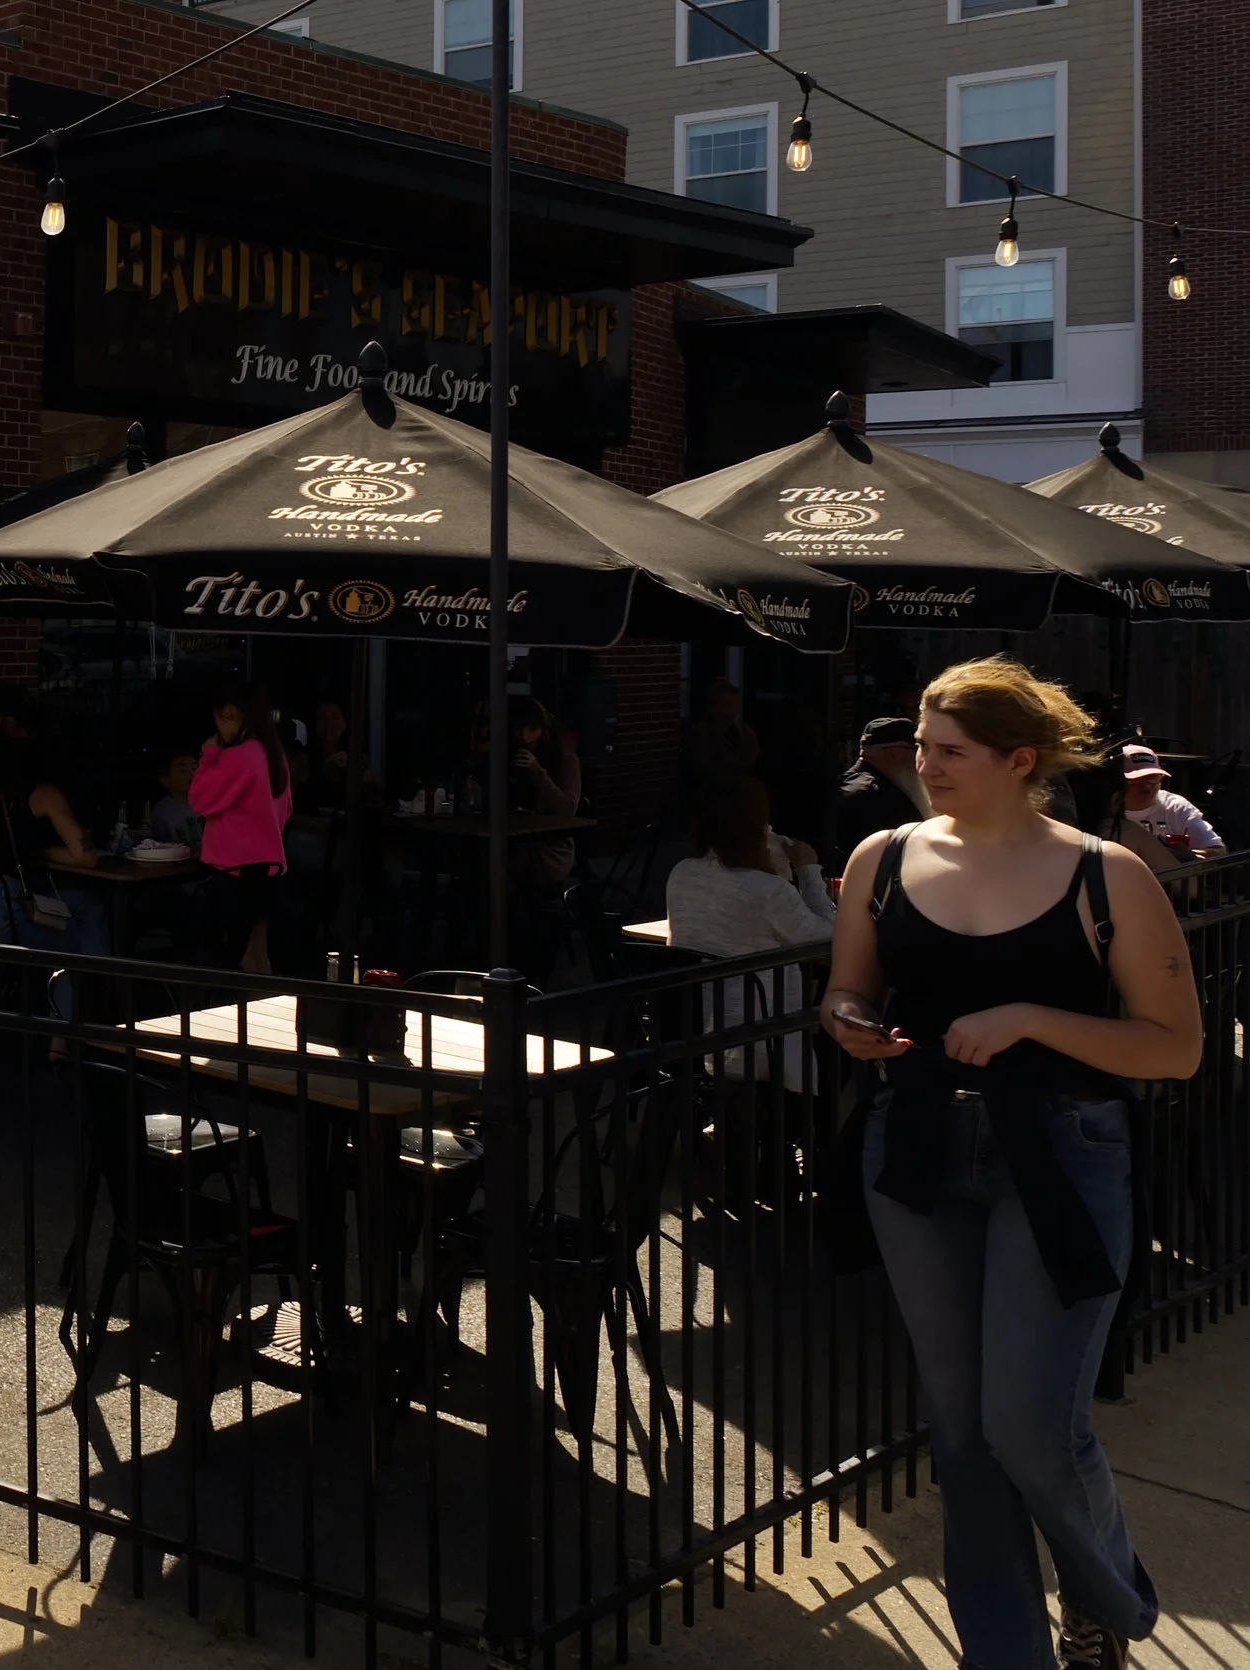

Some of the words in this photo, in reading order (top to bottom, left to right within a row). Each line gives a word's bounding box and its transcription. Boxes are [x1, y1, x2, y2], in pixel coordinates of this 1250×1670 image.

[103, 214, 384, 329] BRODIE'S
[230, 343, 299, 385] Fine
[304, 353, 363, 393] Foo
[384, 363, 438, 399] and
[437, 369, 520, 414] Spirs
[267, 504, 443, 524] Handmade
[284, 532, 337, 540] AUSTIN
[310, 523, 398, 533] VODKA
[762, 528, 905, 542] Handmade
[401, 585, 529, 613] Handmde
[875, 584, 977, 605] Handmade
[759, 594, 811, 620] Handmade
[888, 604, 960, 618] VODKA
[417, 611, 489, 630] VODK
[769, 619, 807, 636] VODKA
